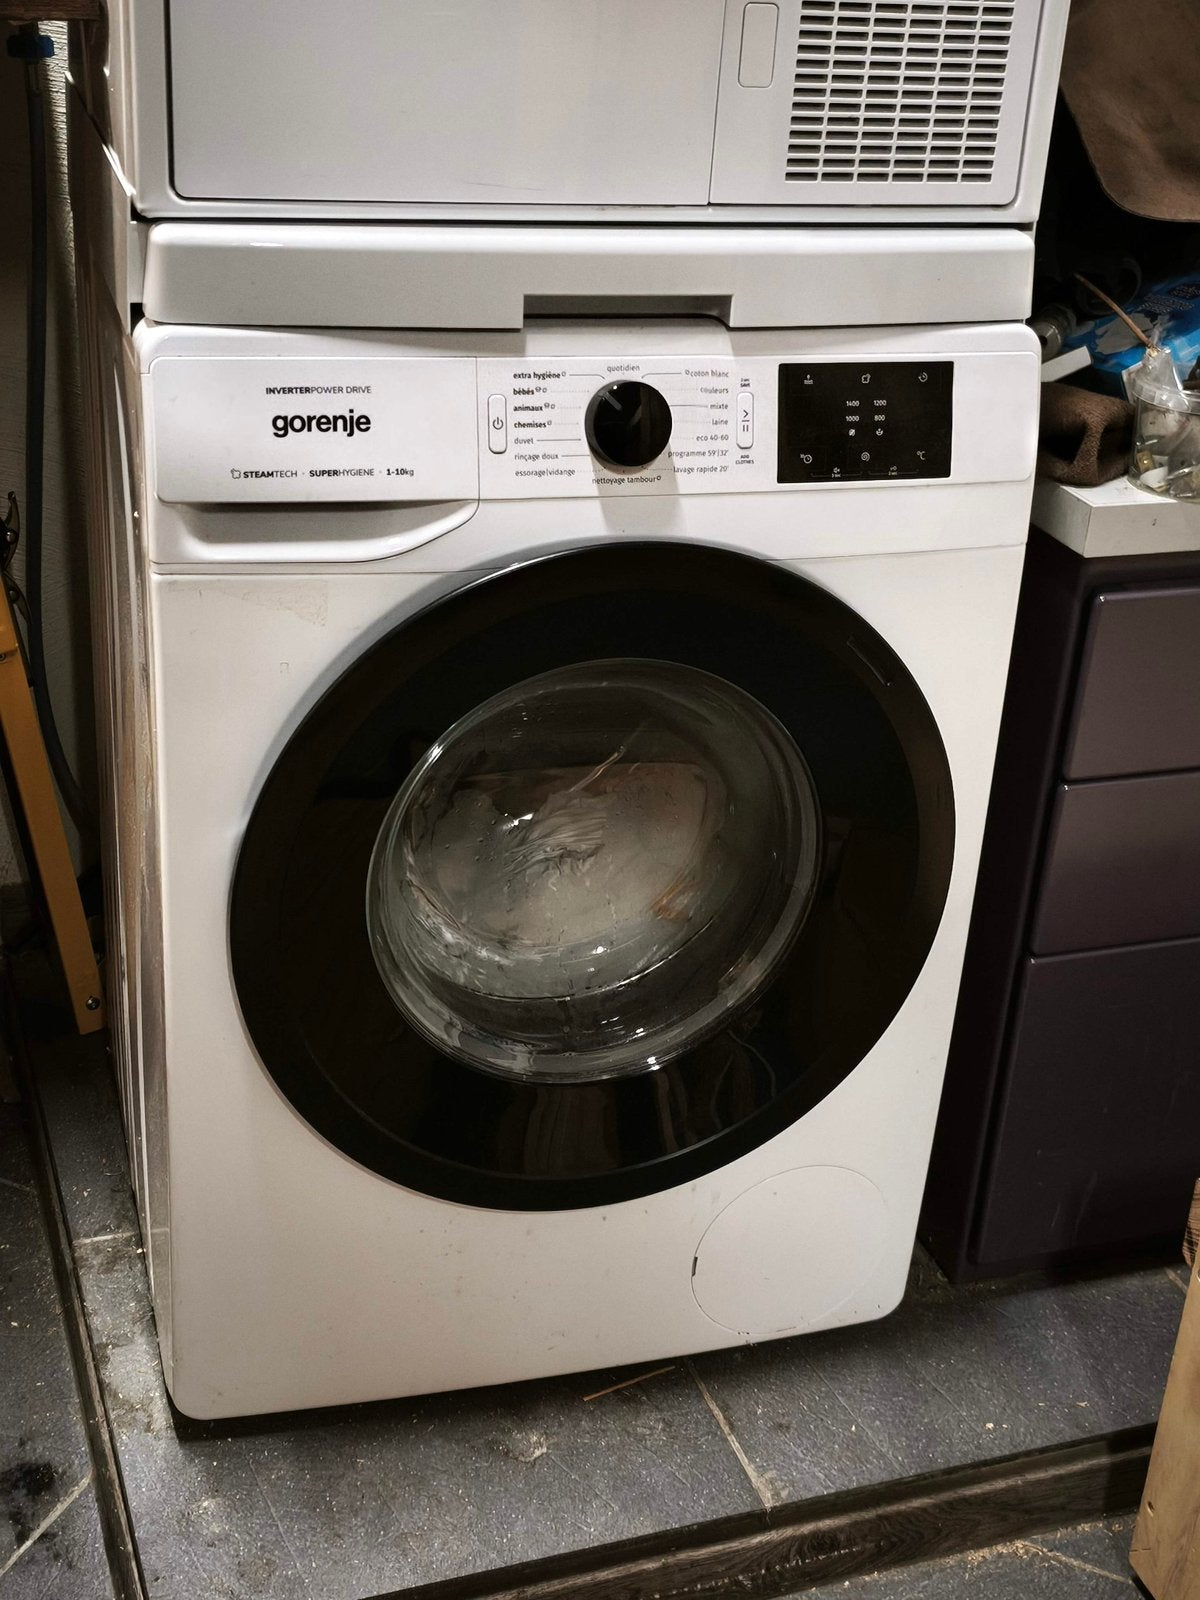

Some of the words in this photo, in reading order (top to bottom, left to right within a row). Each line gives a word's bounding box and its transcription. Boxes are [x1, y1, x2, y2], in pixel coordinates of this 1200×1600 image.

[607, 364, 640, 372] quotidien
[711, 369, 729, 377] blanc
[265, 386, 343, 395] INVERTERPOWER
[345, 386, 372, 394] DRIVE
[271, 408, 371, 438] gorenje
[513, 420, 547, 428] chemises
[514, 437, 534, 445] duvet
[514, 453, 540, 461] rinçage
[667, 450, 706, 458] programme
[243, 470, 298, 479] STEAMTECH
[309, 468, 375, 477] SUPERHYGIENE
[386, 468, 414, 477] 1-10kg
[673, 466, 694, 475] lavage
[696, 465, 718, 473] rapide
[592, 475, 625, 485] nettoyage
[626, 475, 656, 483] tambour
